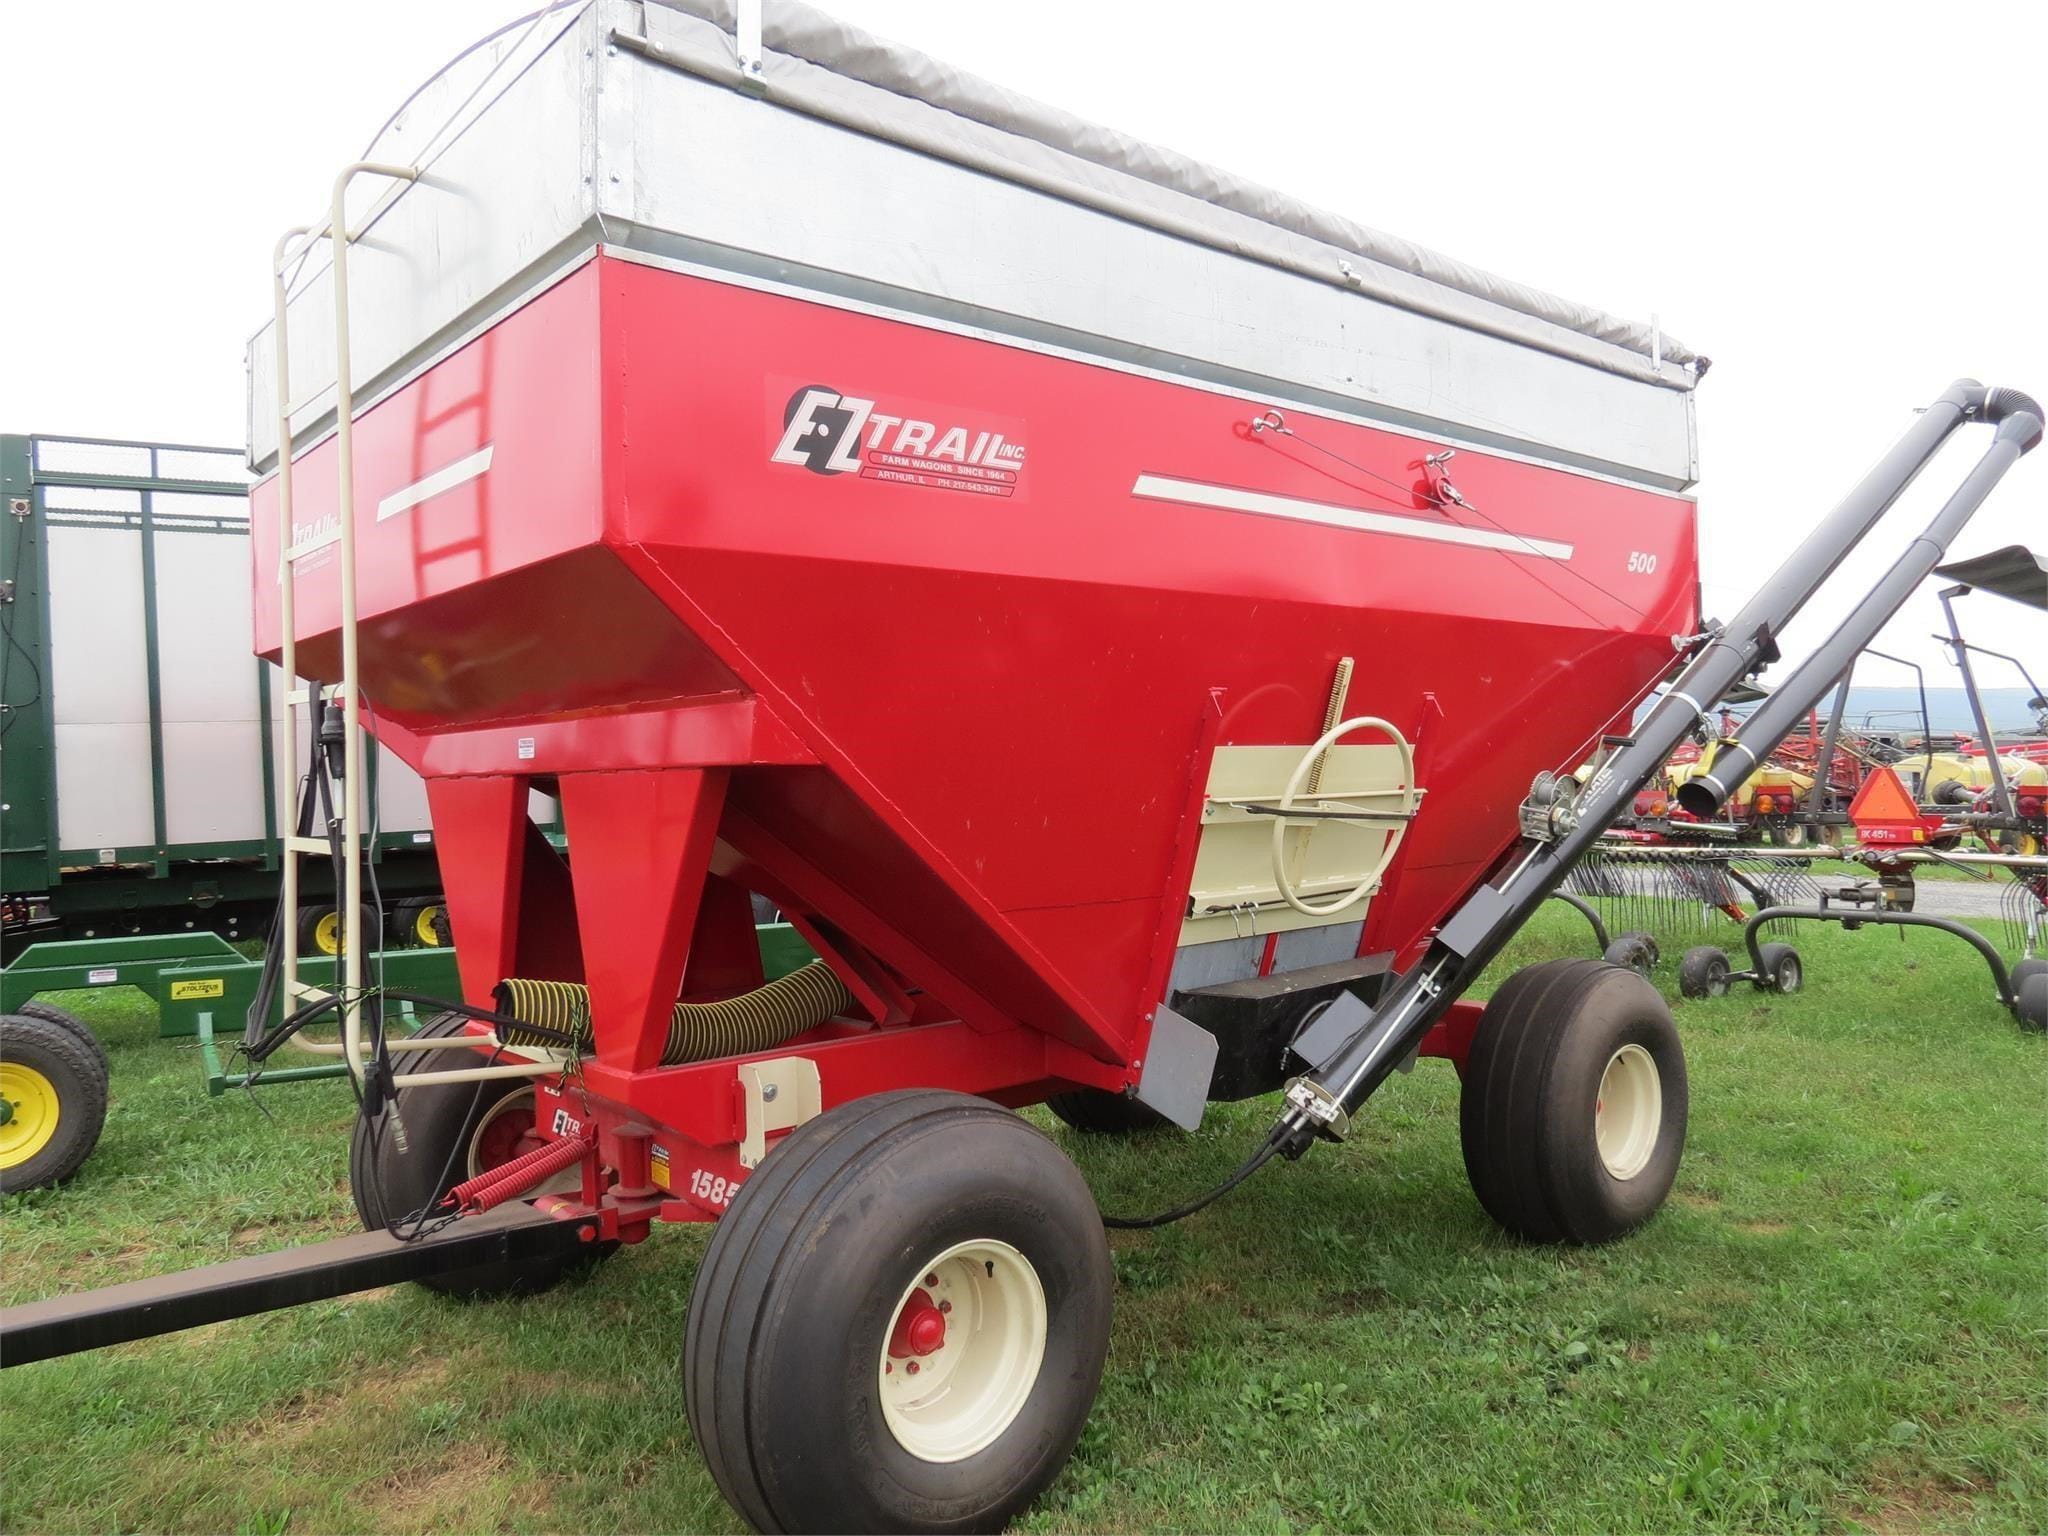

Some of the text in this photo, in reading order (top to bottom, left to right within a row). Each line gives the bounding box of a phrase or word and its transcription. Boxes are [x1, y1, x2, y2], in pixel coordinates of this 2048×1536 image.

[866, 413, 1023, 470] TRAIL
[882, 454, 909, 466] FARM
[912, 459, 953, 473] WAGONS
[957, 465, 984, 478] SINCE
[1628, 551, 1657, 575] 500
[1871, 829, 1888, 839] 451
